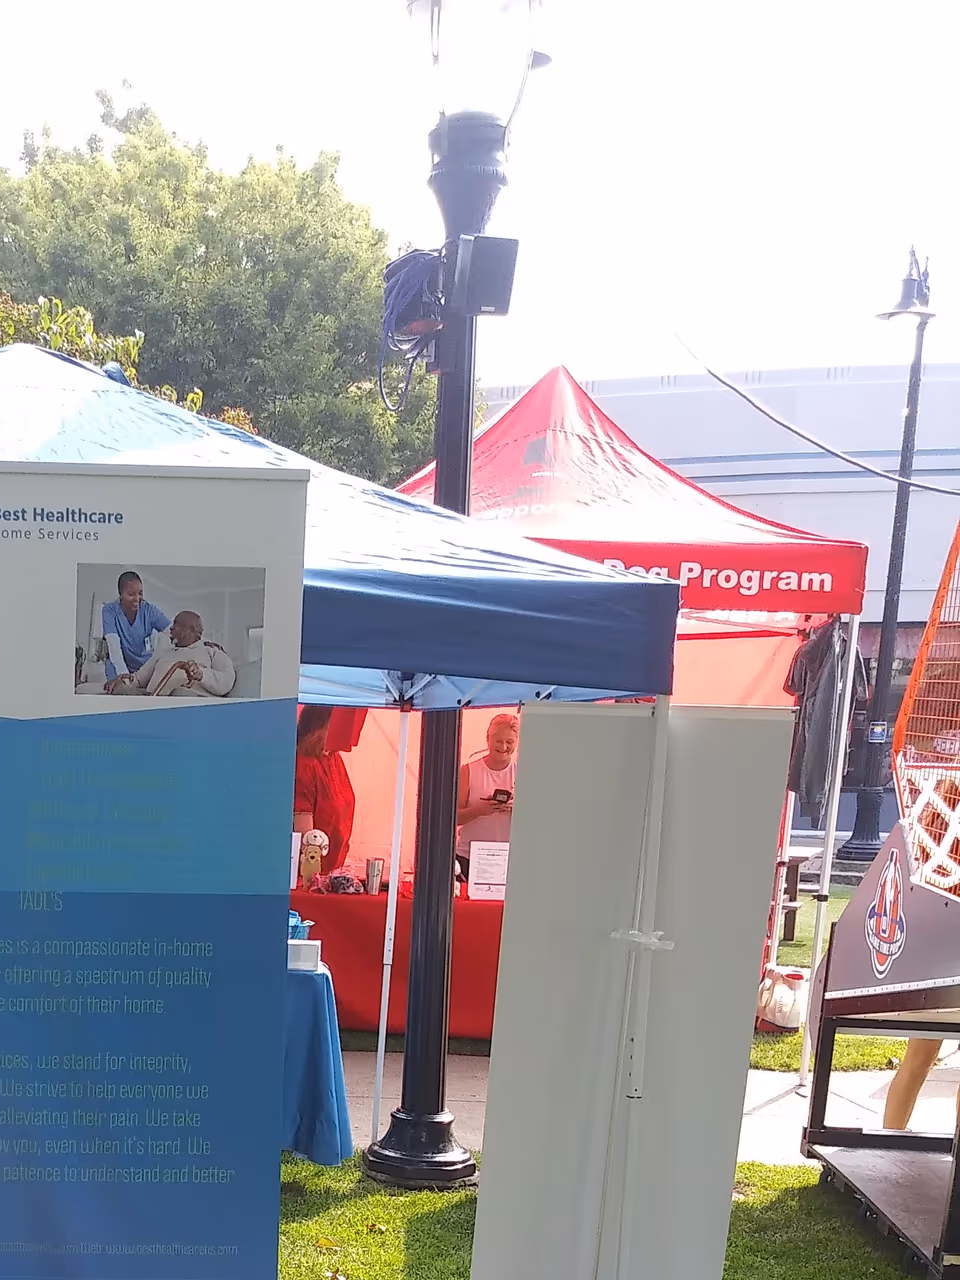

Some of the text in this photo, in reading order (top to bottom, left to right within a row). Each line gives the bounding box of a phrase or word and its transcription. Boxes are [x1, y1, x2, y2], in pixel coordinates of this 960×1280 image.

[33, 507, 123, 524] Healthcare
[39, 527, 99, 541] Services
[680, 561, 833, 596] Program
[16, 936, 29, 954] is
[32, 940, 39, 954] a
[44, 938, 149, 957] compassionate
[154, 937, 213, 957] in-home
[4, 963, 61, 986] offering
[64, 969, 72, 984] a
[76, 967, 144, 986] spectrum
[148, 967, 162, 986] of
[165, 966, 211, 988] quality
[8, 994, 65, 1014] comfort
[69, 996, 84, 1015] of
[87, 995, 120, 1013] their
[37, 1054, 60, 1069] we
[63, 1052, 101, 1070] stand
[105, 1052, 125, 1072] for
[129, 1052, 192, 1073] integrity,
[0, 1079, 23, 1097] We
[26, 1080, 67, 1097] strive
[69, 1081, 83, 1097] to
[87, 1080, 115, 1101] help
[119, 1084, 183, 1101] everyone
[186, 1084, 209, 1099] we
[0, 1106, 68, 1128] alleviating
[72, 1107, 104, 1125] their
[145, 1108, 169, 1126] We
[172, 1108, 201, 1126] take
[13, 1137, 41, 1156] you,
[45, 1138, 77, 1154] even
[80, 1136, 120, 1154] when
[123, 1136, 145, 1154] it's
[187, 1136, 211, 1155] We
[3, 1162, 61, 1182] patience
[64, 1164, 78, 1181] to
[80, 1164, 160, 1182] understand
[163, 1165, 188, 1182] and
[192, 1165, 235, 1183] better
